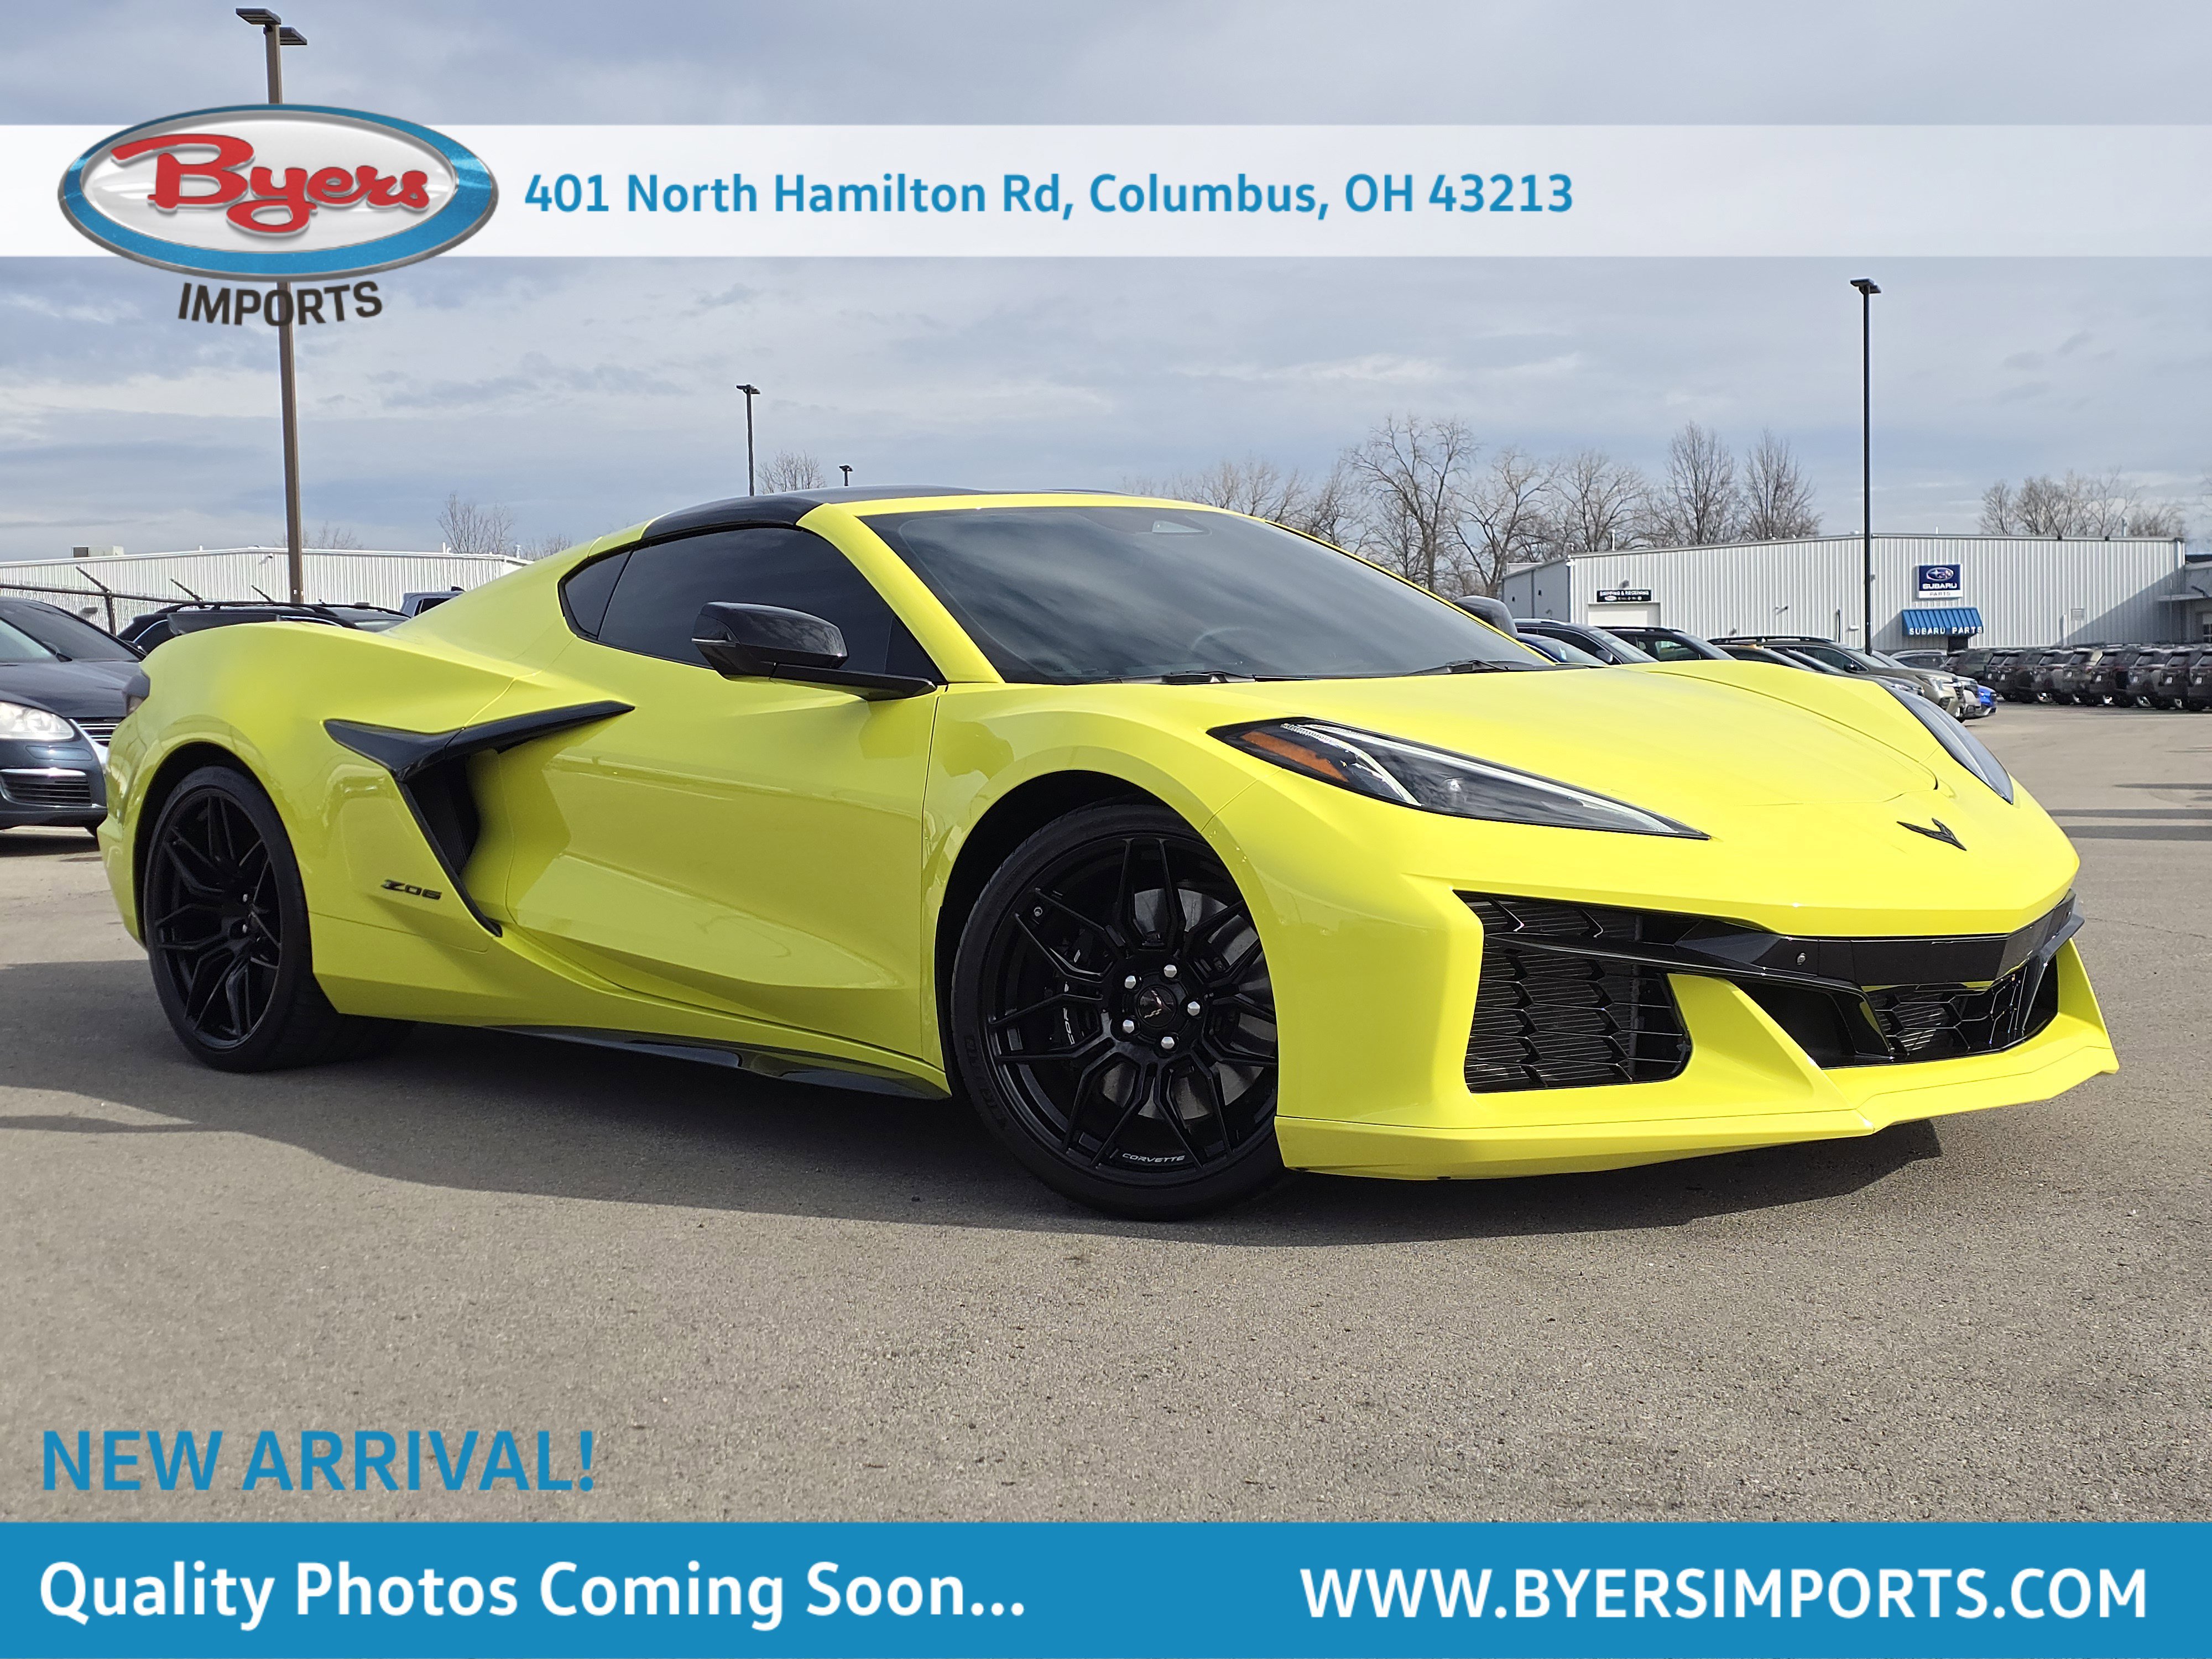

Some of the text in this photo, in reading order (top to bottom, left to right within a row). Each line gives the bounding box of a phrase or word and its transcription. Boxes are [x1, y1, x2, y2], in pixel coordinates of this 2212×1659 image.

[1909, 626, 1983, 635] SUBARU PARTS
[1122, 1153, 1186, 1162] CORVETTE
